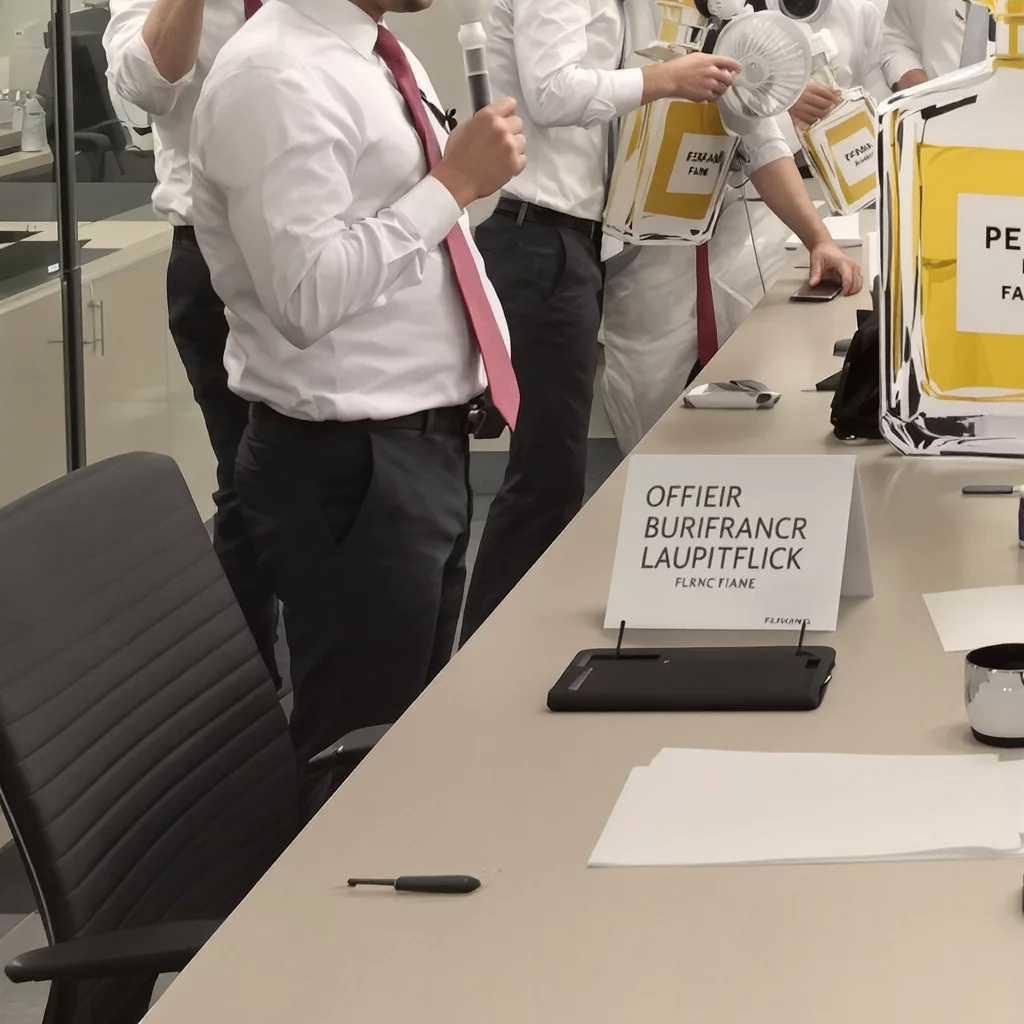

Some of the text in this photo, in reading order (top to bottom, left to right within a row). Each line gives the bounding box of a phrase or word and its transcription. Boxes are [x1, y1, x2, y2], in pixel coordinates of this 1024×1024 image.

[646, 485, 742, 508] OFFIEIR
[644, 516, 808, 540] BURIFRANCR
[641, 546, 804, 570] LAUPITFLICK
